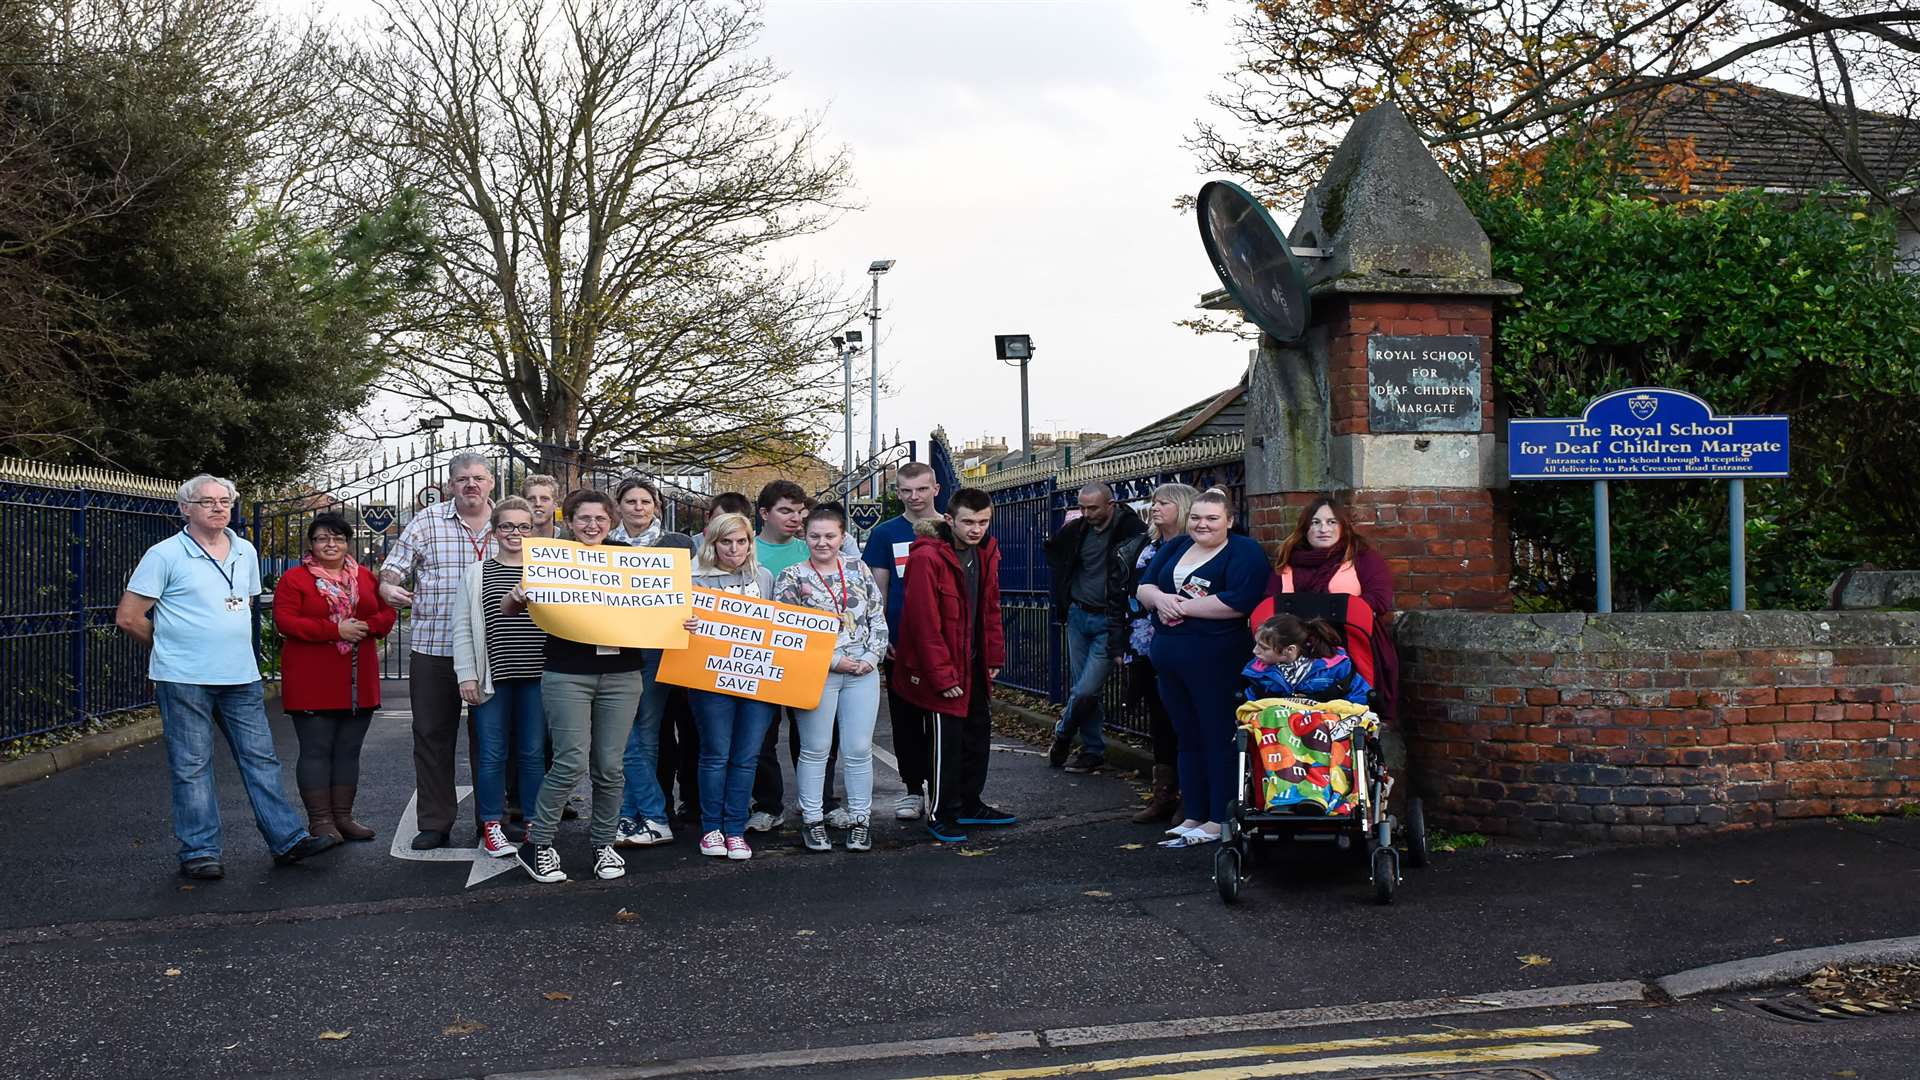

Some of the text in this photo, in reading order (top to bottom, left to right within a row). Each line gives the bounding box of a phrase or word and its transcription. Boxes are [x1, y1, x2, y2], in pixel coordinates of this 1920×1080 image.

[1376, 350, 1475, 361] ROYAL SCHOOL
[1412, 368, 1438, 378] FOR
[1377, 385, 1474, 396] DEAF CHILDREN
[1397, 403, 1455, 413] MARGATE
[1566, 422, 1734, 441] The Royal School
[1520, 440, 1781, 457] for Deaf Children Margate
[1663, 456, 1700, 465] through
[1704, 456, 1750, 464] Reception
[1559, 465, 1601, 473] deliveries
[531, 547, 671, 568] SAVE THE ROYAL
[527, 565, 671, 589] SCHOOL FOR DEAF
[525, 591, 684, 606] CHILDREN MARGATE
[720, 599, 772, 619] ROYAL
[777, 611, 836, 632] SCHOOL
[697, 622, 803, 649] HILDREN FOR
[733, 647, 772, 662] DEAF
[707, 657, 785, 679] MARGATE
[717, 676, 757, 692] SAVE
